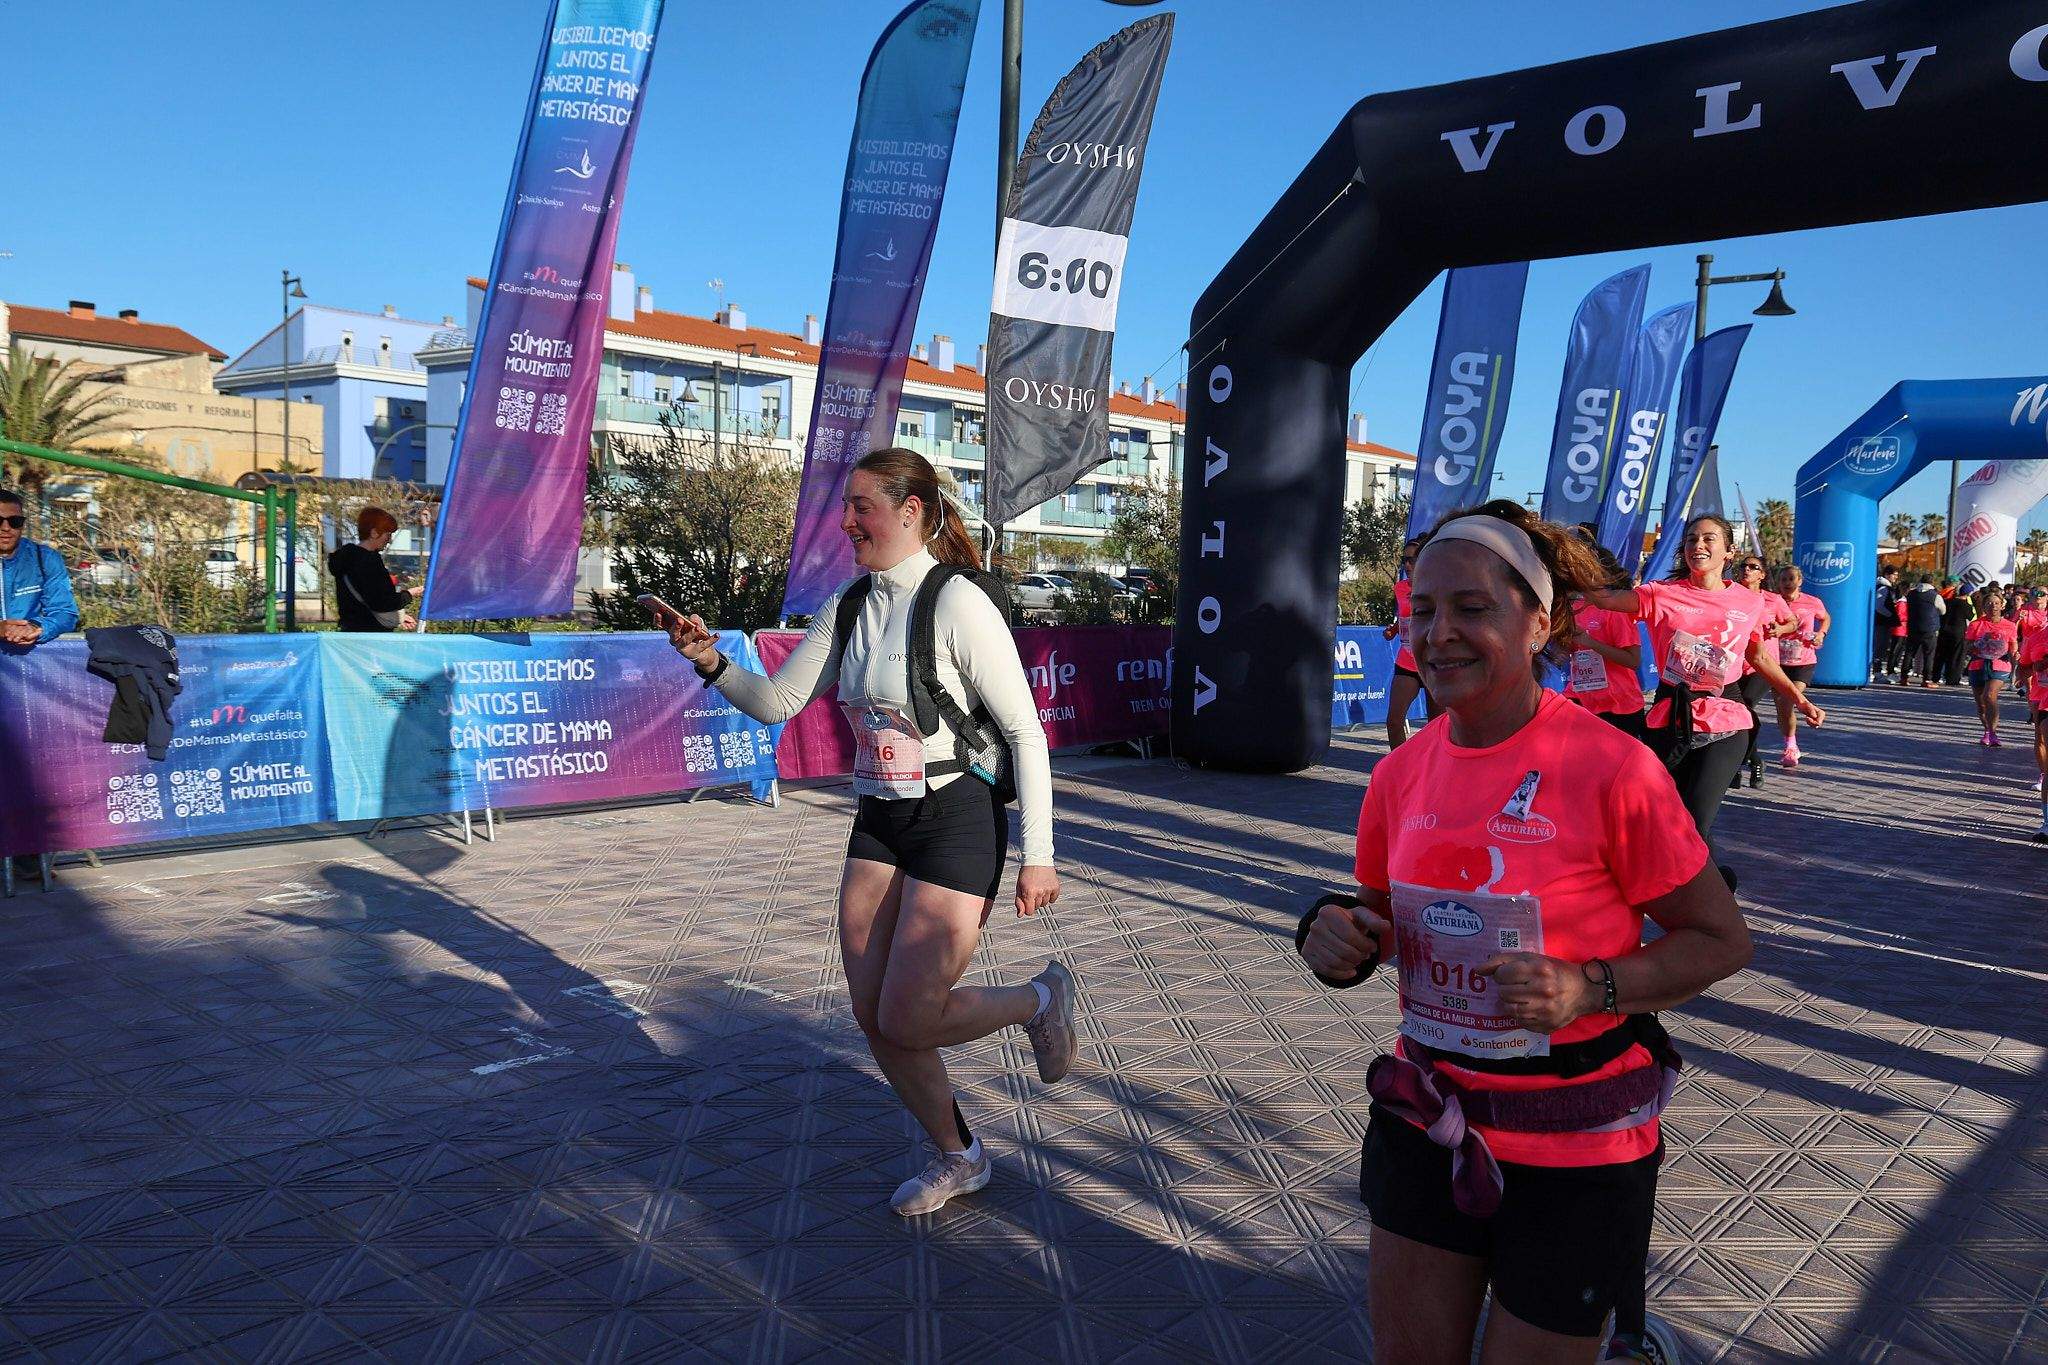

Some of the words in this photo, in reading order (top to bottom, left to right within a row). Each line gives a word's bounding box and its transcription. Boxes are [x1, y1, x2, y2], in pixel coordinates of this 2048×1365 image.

[552, 26, 655, 51] VISIBILICEMOS
[556, 51, 606, 69] JUNTOS
[610, 53, 630, 74] EL
[541, 70, 583, 94] CÁNCER
[585, 76, 605, 95] DE
[607, 79, 639, 102] MAM
[857, 140, 949, 160] VISIBILICEMOS
[1046, 142, 1137, 170] OYSHO
[864, 160, 910, 176] JUNTOS
[912, 162, 927, 178] EL
[847, 177, 890, 194] CÁNCER
[892, 181, 906, 196] DE
[909, 183, 943, 200] MAMA
[850, 198, 932, 220] METASTÁSICO
[1017, 251, 1114, 299] 6:00
[508, 329, 565, 359] SÚMATE
[504, 355, 571, 378] MOVIMIENTO
[822, 380, 871, 404] SÚMATE
[1005, 377, 1096, 413] OYSHO
[101, 396, 177, 412] ONSTRUCCIONES
[187, 404, 193, 413] Y
[204, 406, 252, 419] REFORMAS
[1434, 351, 1489, 486] GOYA
[1562, 388, 1610, 502] GOYA
[1850, 445, 1896, 464] Marlene
[1616, 409, 1659, 515] GOYA
[1193, 364, 1233, 716] VOLVO
[1802, 551, 1850, 573] Marlene
[444, 659, 595, 684] VISIBILICEMOS
[1028, 650, 1076, 700] nfe
[1117, 647, 1175, 691] renf
[1684, 661, 1707, 676] 016
[439, 692, 518, 716] JUNTOS
[521, 691, 548, 714] EL
[451, 719, 529, 749] CÁNCER
[532, 722, 558, 745] DE
[560, 719, 613, 743] MAMA
[229, 761, 292, 784] SÚMATE
[292, 764, 311, 778] AL
[475, 747, 609, 782] METASTÁSICO
[230, 780, 313, 801] MOVIMIENTO
[1492, 818, 1551, 837] ASTURIANA
[1425, 910, 1480, 931] ASTURIANA
[1431, 961, 1487, 993] 016
[1442, 995, 1468, 1011] 5389
[1432, 1010, 1441, 1019] DE
[1441, 1011, 1450, 1020] LA
[1452, 1013, 1476, 1027] MUJER
[1482, 1017, 1518, 1028] VALENCI
[1472, 1037, 1528, 1049] Santander
